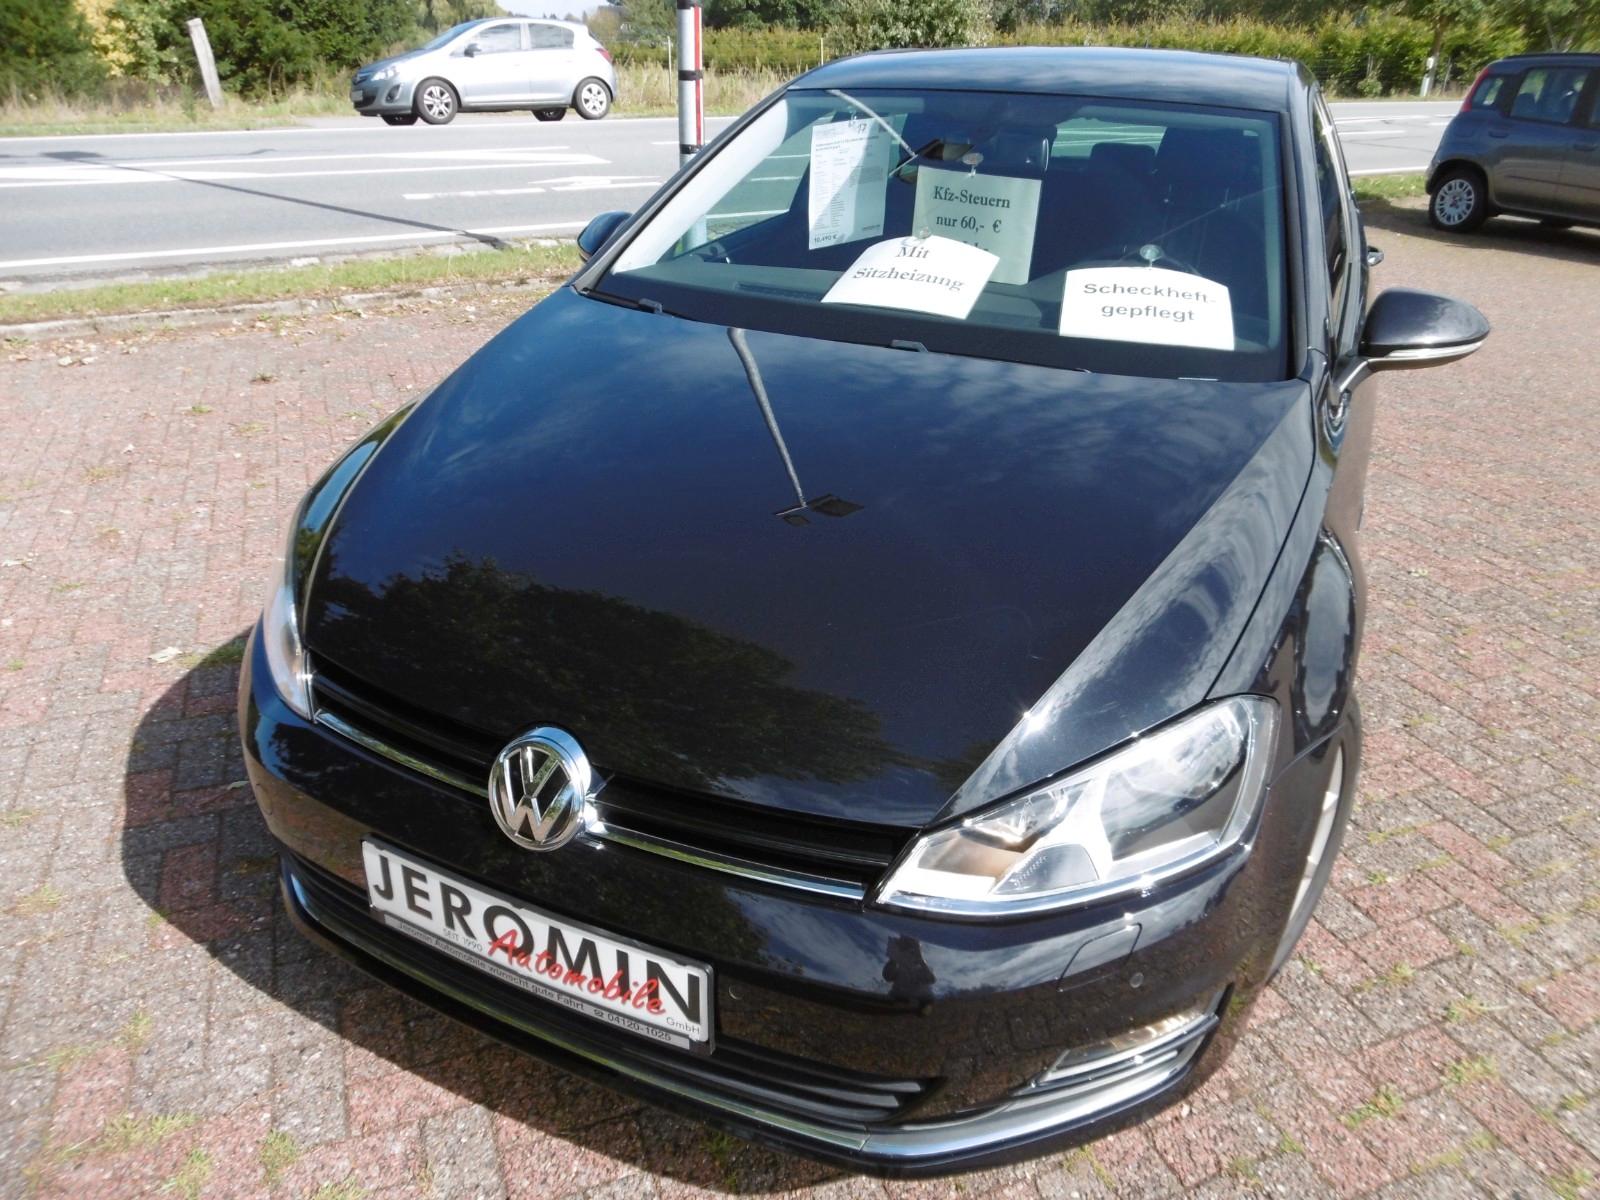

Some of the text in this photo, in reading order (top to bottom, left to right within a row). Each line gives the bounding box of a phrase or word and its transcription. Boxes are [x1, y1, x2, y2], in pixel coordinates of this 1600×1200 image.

[933, 184, 1011, 209] Kfz-Steuern
[935, 214, 1002, 234] nur 60,- €
[895, 246, 930, 260] Mit
[852, 266, 965, 292] Sitzheizung
[1101, 304, 1196, 323] gepflegt
[373, 854, 702, 1026] JEROMIN
[487, 928, 667, 1017] Automobile
[531, 982, 556, 1000] gute
[556, 991, 585, 1012] Fahrt
[607, 1012, 672, 1043] 04120-1025
[665, 1016, 701, 1036] GmbH
